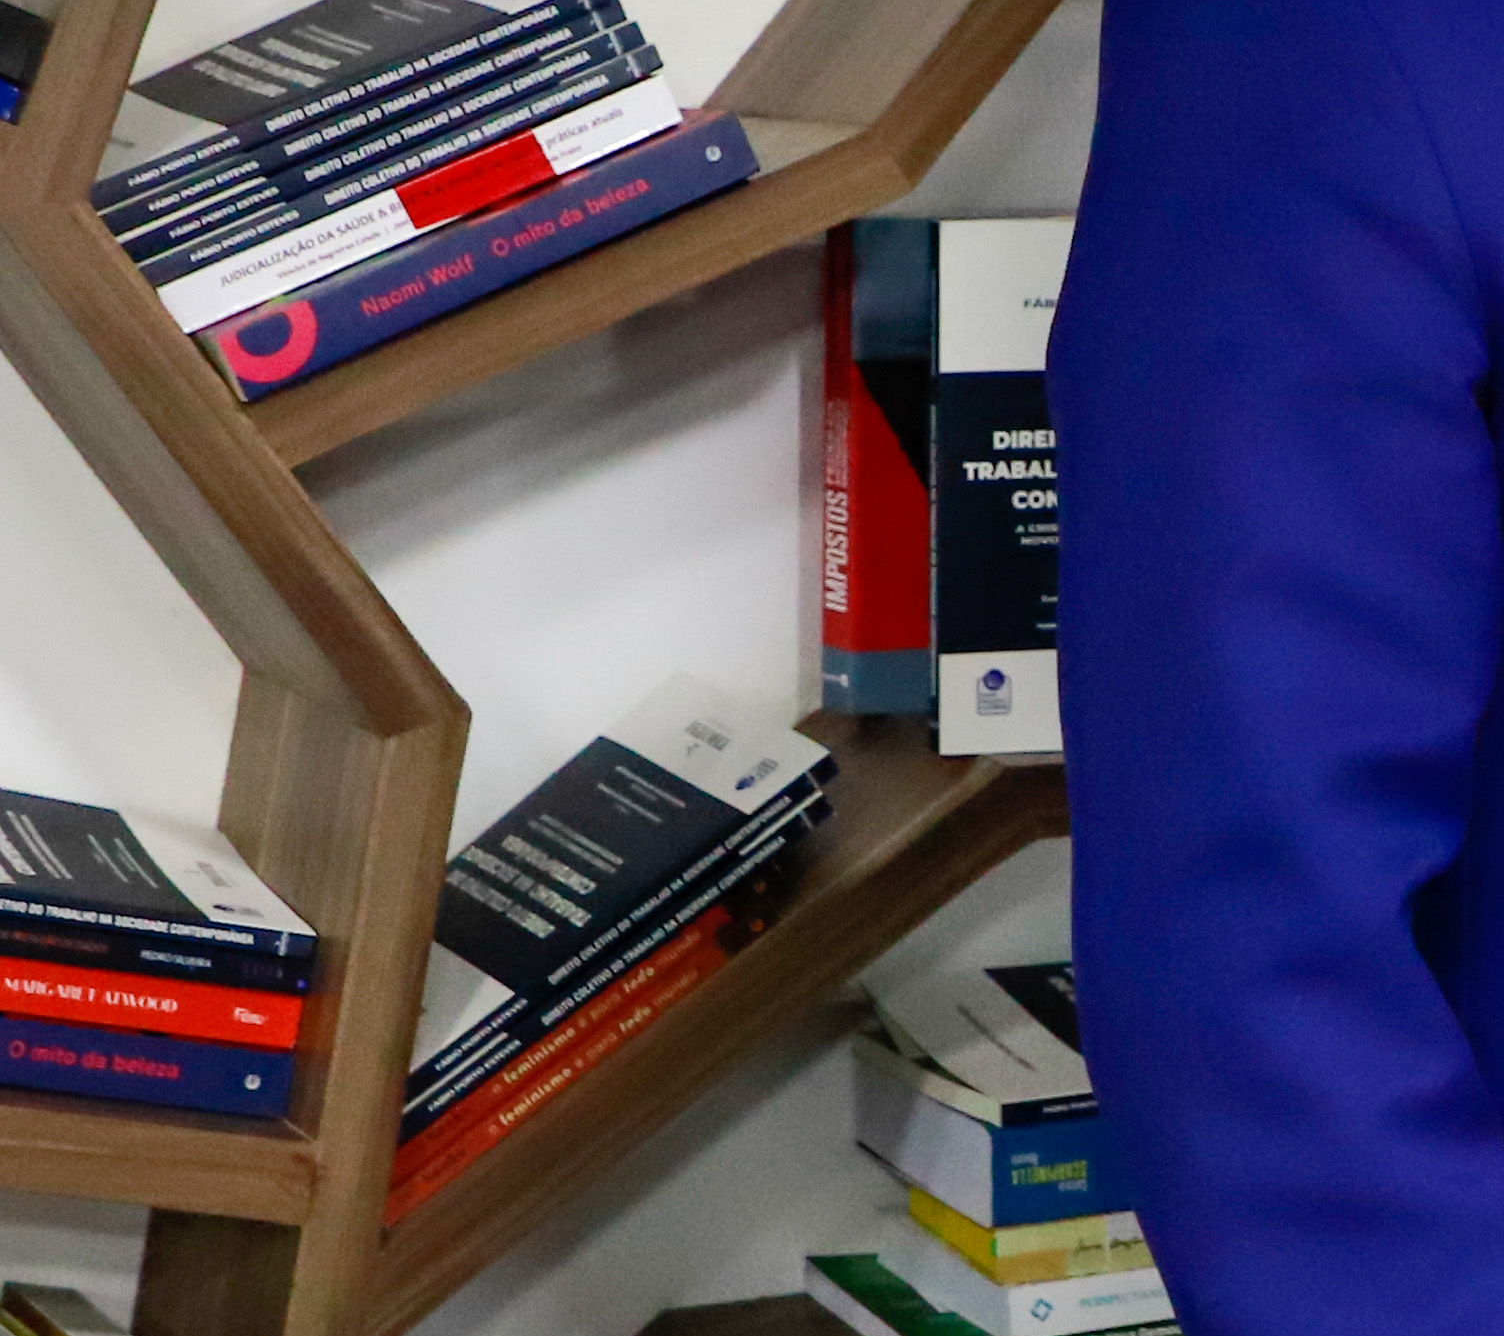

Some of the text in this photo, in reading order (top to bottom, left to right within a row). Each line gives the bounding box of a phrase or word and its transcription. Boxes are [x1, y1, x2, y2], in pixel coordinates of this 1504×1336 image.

[544, 108, 624, 151] práticas atuais
[220, 238, 316, 288] JUDICIALIZAÇÃO
[316, 230, 336, 246] DA
[335, 212, 376, 237] SAÚDE
[360, 178, 651, 317] Naomi Wolf O mito da beleza
[824, 489, 848, 616] IMPOSTOS
[4, 977, 178, 1013] MARGARET ATWOOD
[7, 1039, 28, 1059] O
[25, 1045, 79, 1066] mito
[77, 1051, 110, 1070] da
[110, 1054, 181, 1080] beleza
[502, 1027, 576, 1084] feminismo
